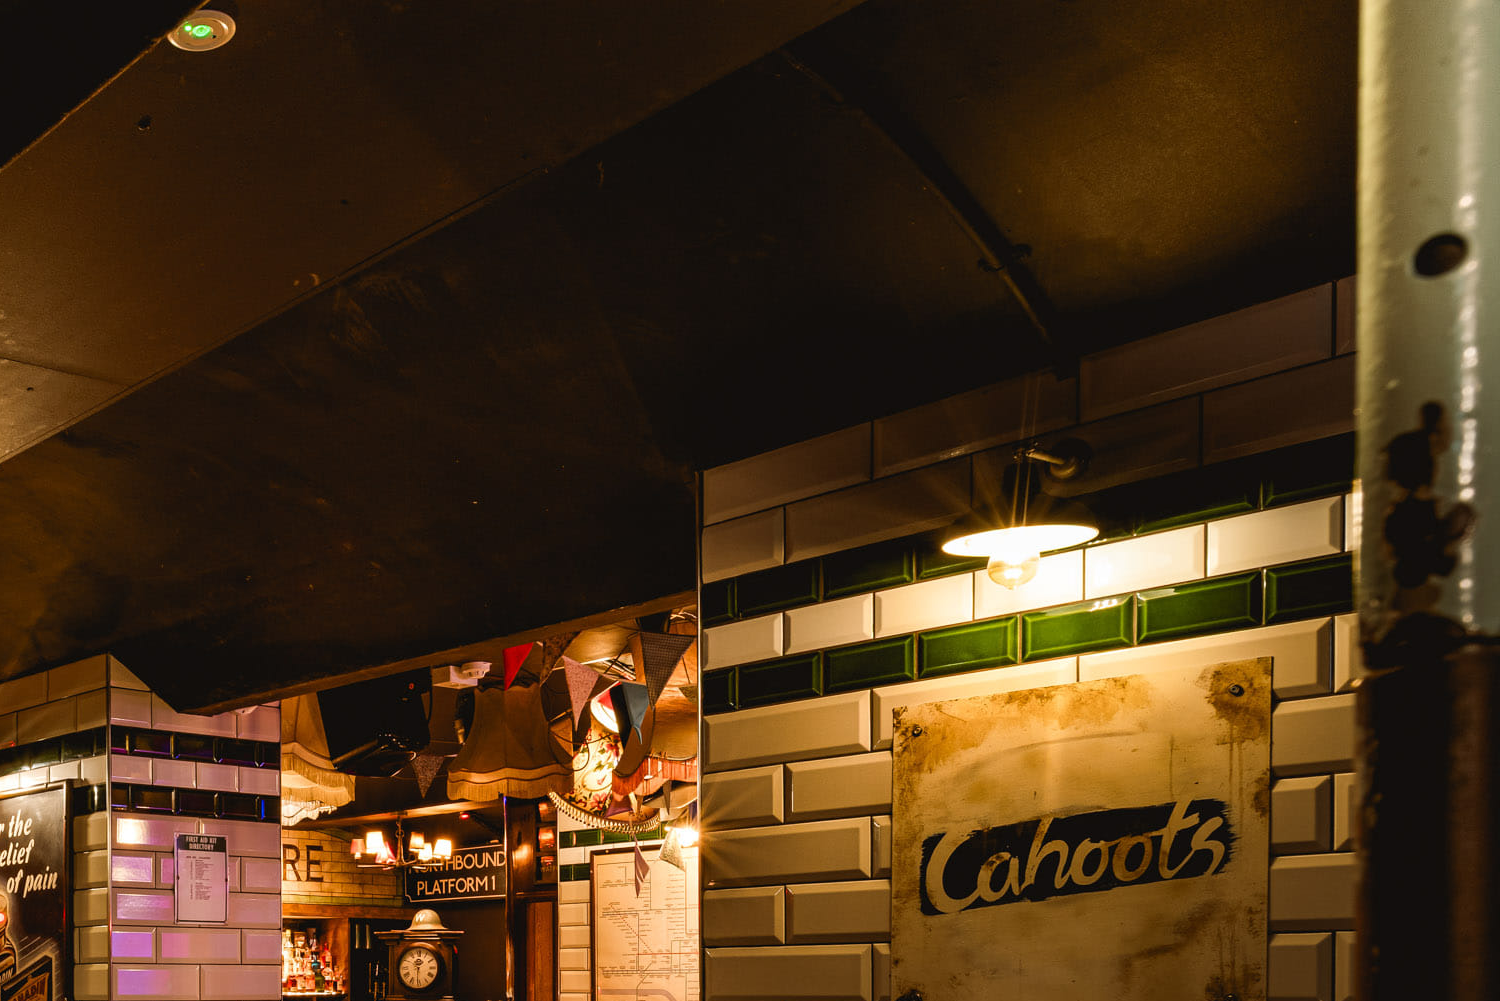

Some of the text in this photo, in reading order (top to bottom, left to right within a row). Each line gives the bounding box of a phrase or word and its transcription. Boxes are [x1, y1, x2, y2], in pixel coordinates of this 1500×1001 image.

[8, 809, 33, 838] the
[926, 799, 1226, 914] Cahoots
[6, 866, 58, 899] of pain
[417, 875, 496, 896] PLATFORM 1
